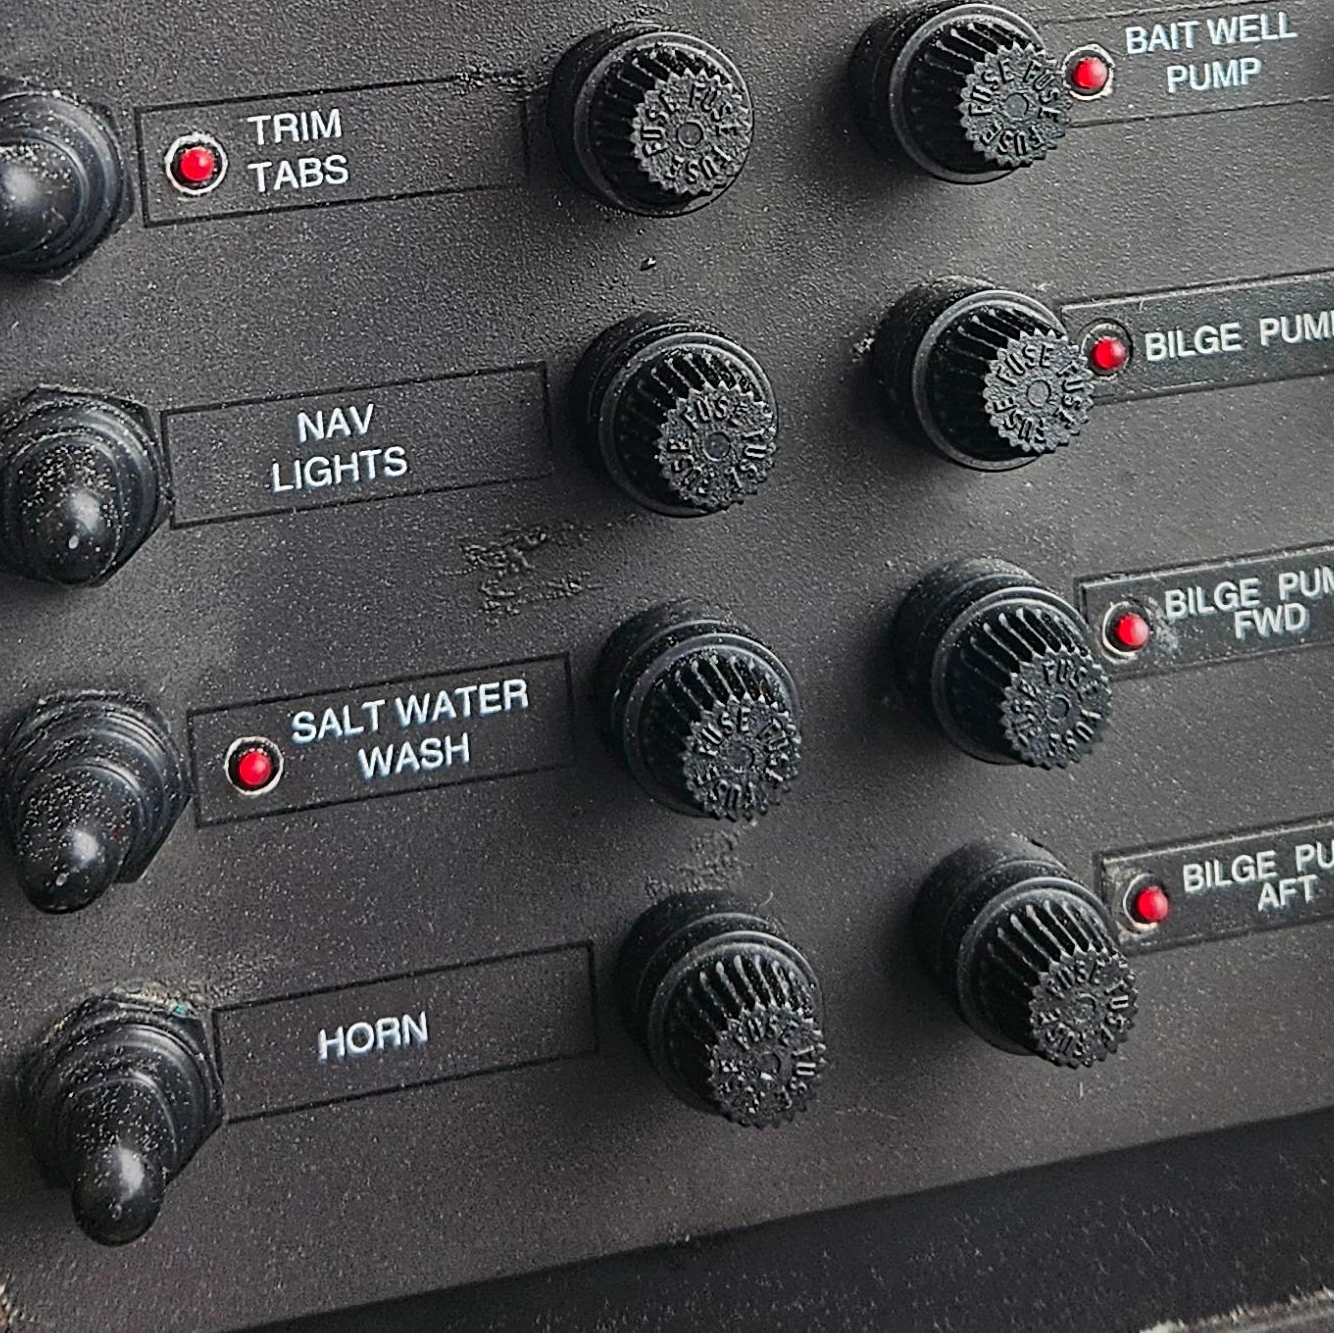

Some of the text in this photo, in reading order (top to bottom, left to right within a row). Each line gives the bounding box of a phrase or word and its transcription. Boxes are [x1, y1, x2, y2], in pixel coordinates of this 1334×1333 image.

[1125, 12, 1298, 55] BAIT WELL
[1167, 58, 1262, 93] PUMP
[248, 109, 342, 146] TRIM
[248, 155, 349, 193] TABS
[1145, 323, 1240, 362] BILGE
[297, 405, 375, 441] NAV
[271, 447, 408, 493] LIGHTS
[1164, 583, 1261, 620] BILGE
[1234, 603, 1308, 638] FWD
[291, 678, 528, 746] SALT WATER
[358, 736, 471, 781] WASH
[1183, 850, 1277, 894] BILGE
[1257, 873, 1320, 911] AFT
[318, 1011, 428, 1061] HORN
